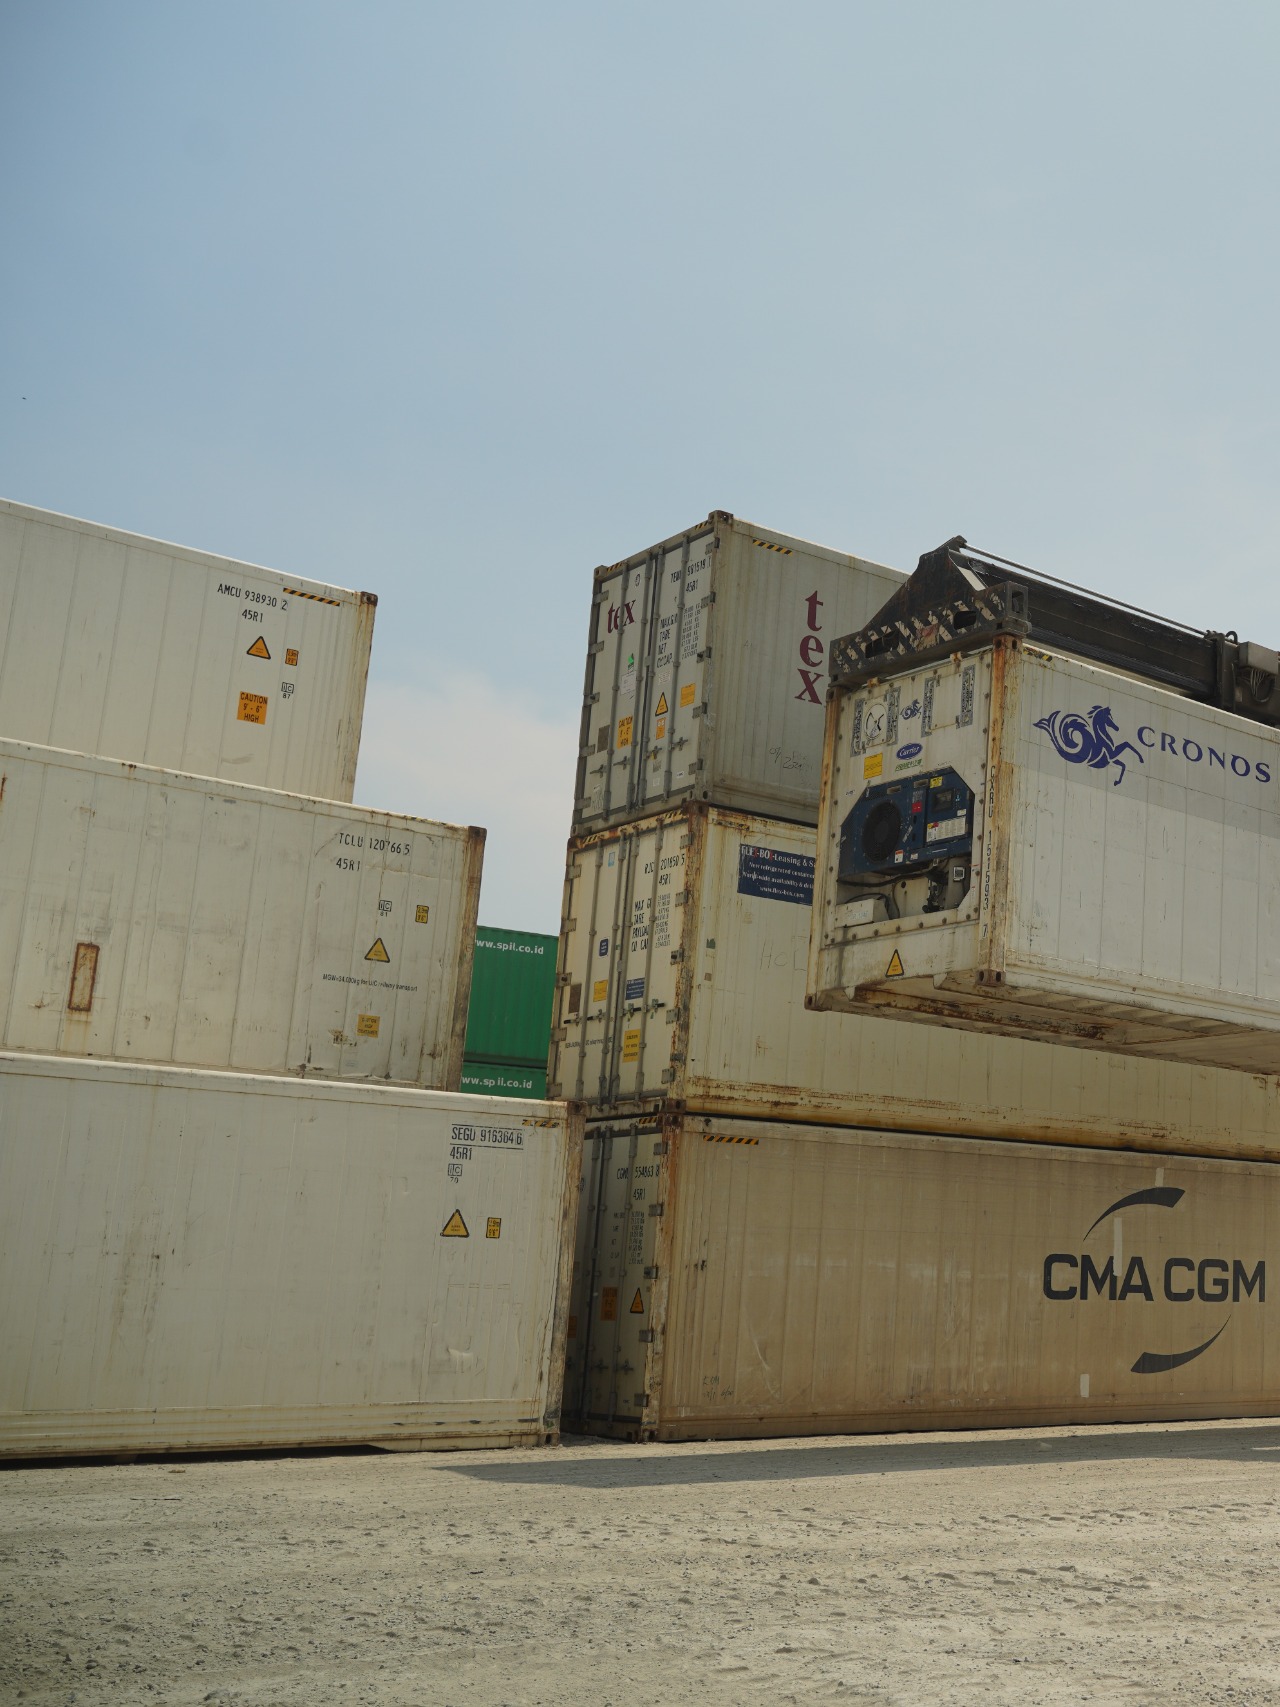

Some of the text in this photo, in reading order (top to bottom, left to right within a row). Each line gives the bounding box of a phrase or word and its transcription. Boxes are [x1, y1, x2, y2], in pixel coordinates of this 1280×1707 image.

[217, 584, 288, 611] AMCU 938930 2
[242, 609, 263, 622] 45R1
[794, 590, 824, 705] tex
[240, 692, 268, 704] CAUTION
[244, 713, 259, 723] HIGH
[900, 746, 920, 757] Carrier
[1138, 726, 1271, 783] CRONOS
[340, 833, 364, 847] TCLU
[336, 858, 360, 872] 45R1
[462, 1076, 532, 1089] ww.spil.co.id
[452, 1127, 476, 1142] SEGU
[480, 1129, 514, 1144] 916364
[450, 1147, 472, 1160] 45R1
[633, 1188, 646, 1201] 45R1
[1043, 1254, 1265, 1303] CMA CGM
